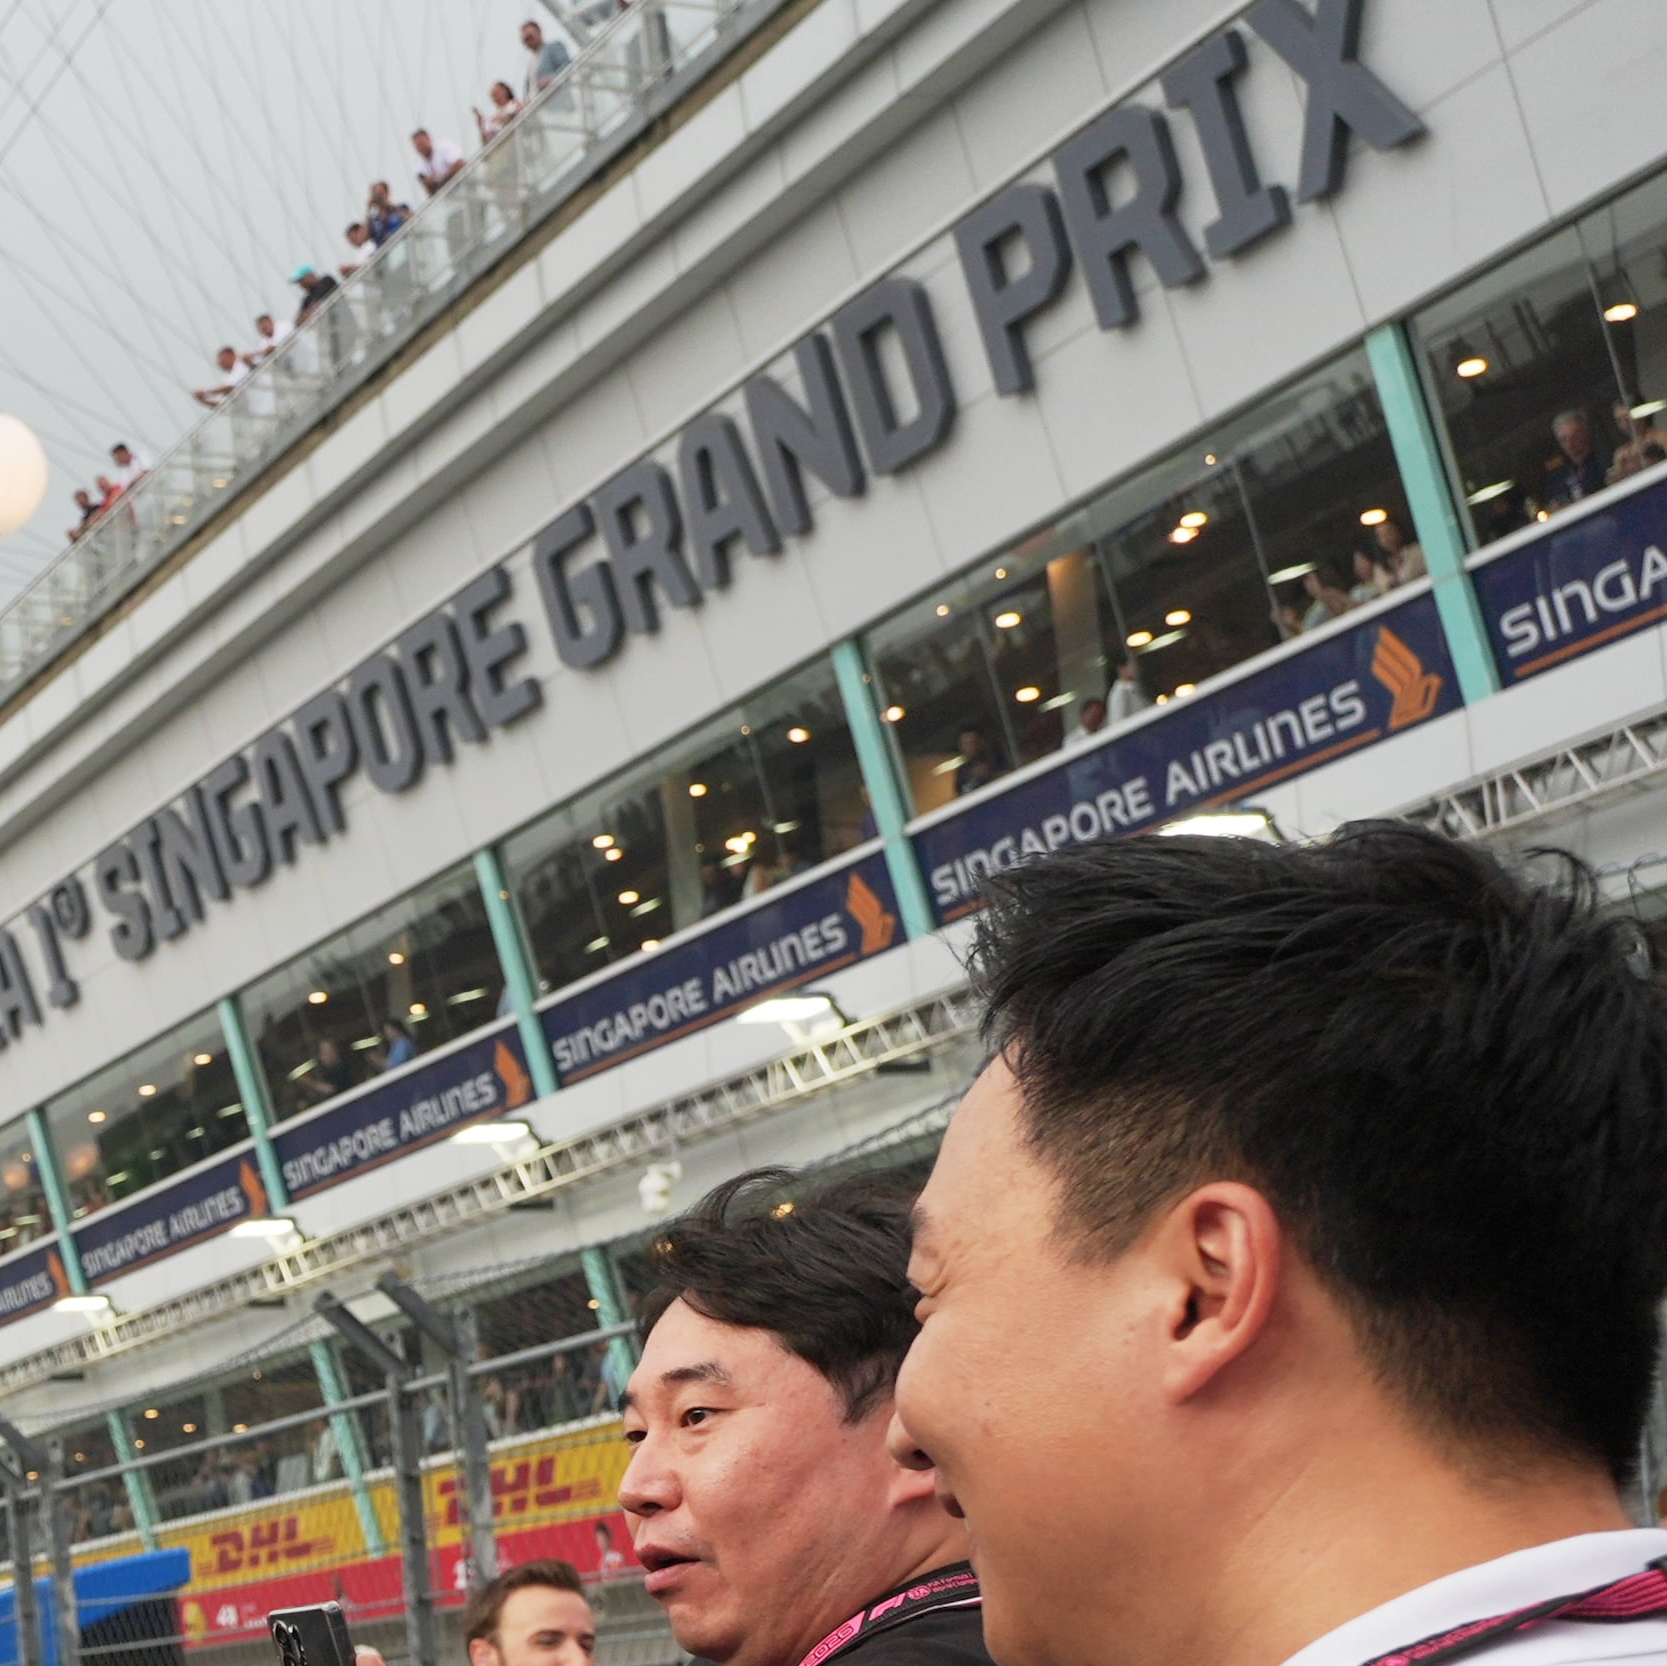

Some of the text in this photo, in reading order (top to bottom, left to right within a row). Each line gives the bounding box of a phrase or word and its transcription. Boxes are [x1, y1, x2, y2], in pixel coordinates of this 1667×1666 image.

[94, 562, 543, 962] SINGAPORE
[532, 275, 958, 669] GRAND
[953, 0, 1431, 397] PRIX
[931, 681, 1365, 905] SINGAPORE AIRLINES
[551, 913, 848, 1071] SINGAPORE AIRLINES
[282, 1071, 497, 1191] SINGAPORE AIRLINES
[210, 1517, 315, 1574] DHL
